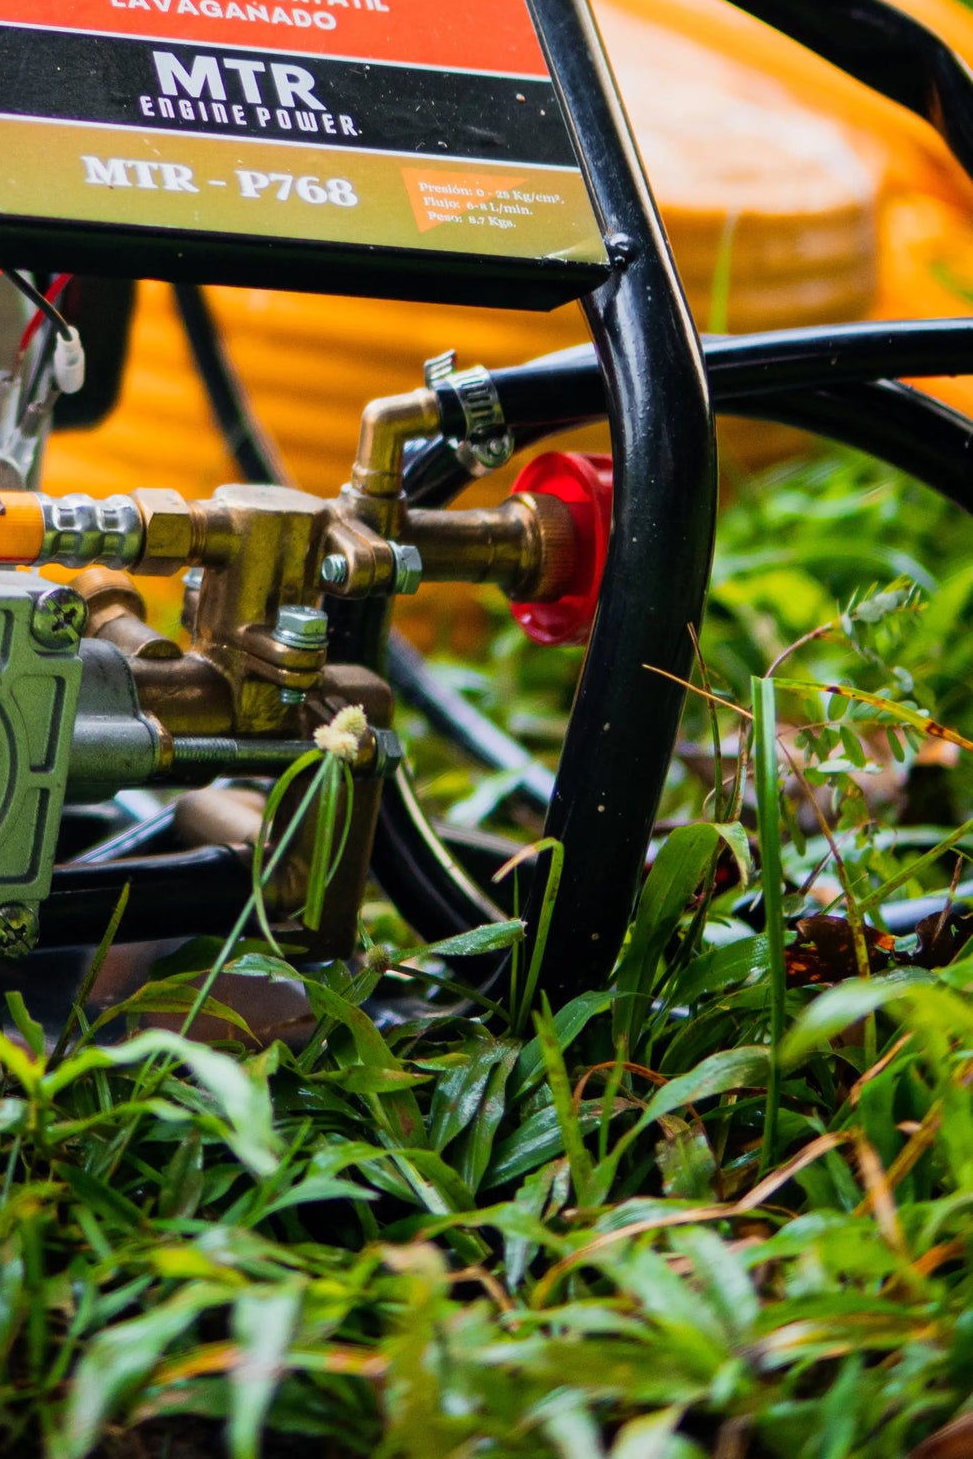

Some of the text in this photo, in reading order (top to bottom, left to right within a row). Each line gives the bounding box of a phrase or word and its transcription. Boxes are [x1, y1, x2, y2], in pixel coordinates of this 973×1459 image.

[152, 50, 327, 111] MTR
[139, 95, 248, 126] ENGINE
[80, 155, 201, 193] MTR
[233, 169, 360, 208] P768
